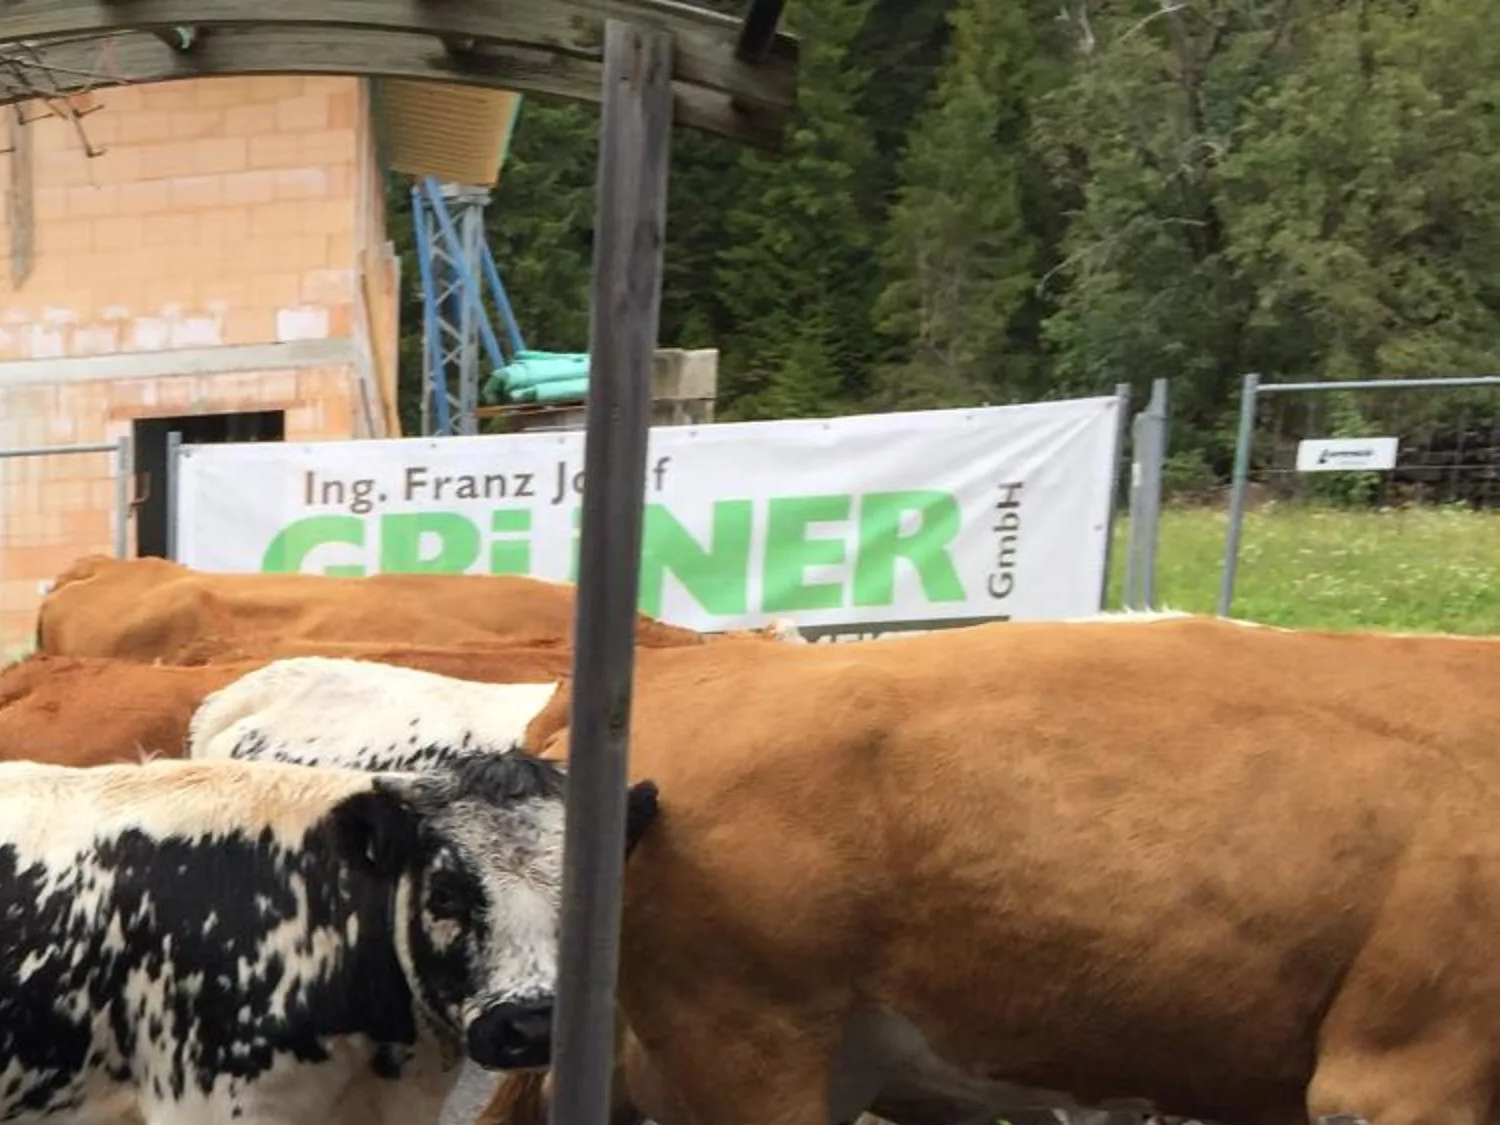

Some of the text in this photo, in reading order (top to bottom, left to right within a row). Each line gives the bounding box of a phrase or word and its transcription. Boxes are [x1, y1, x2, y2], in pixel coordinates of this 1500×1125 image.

[303, 456, 672, 515] Ing. Franz Jof
[987, 480, 1024, 600] GmbH
